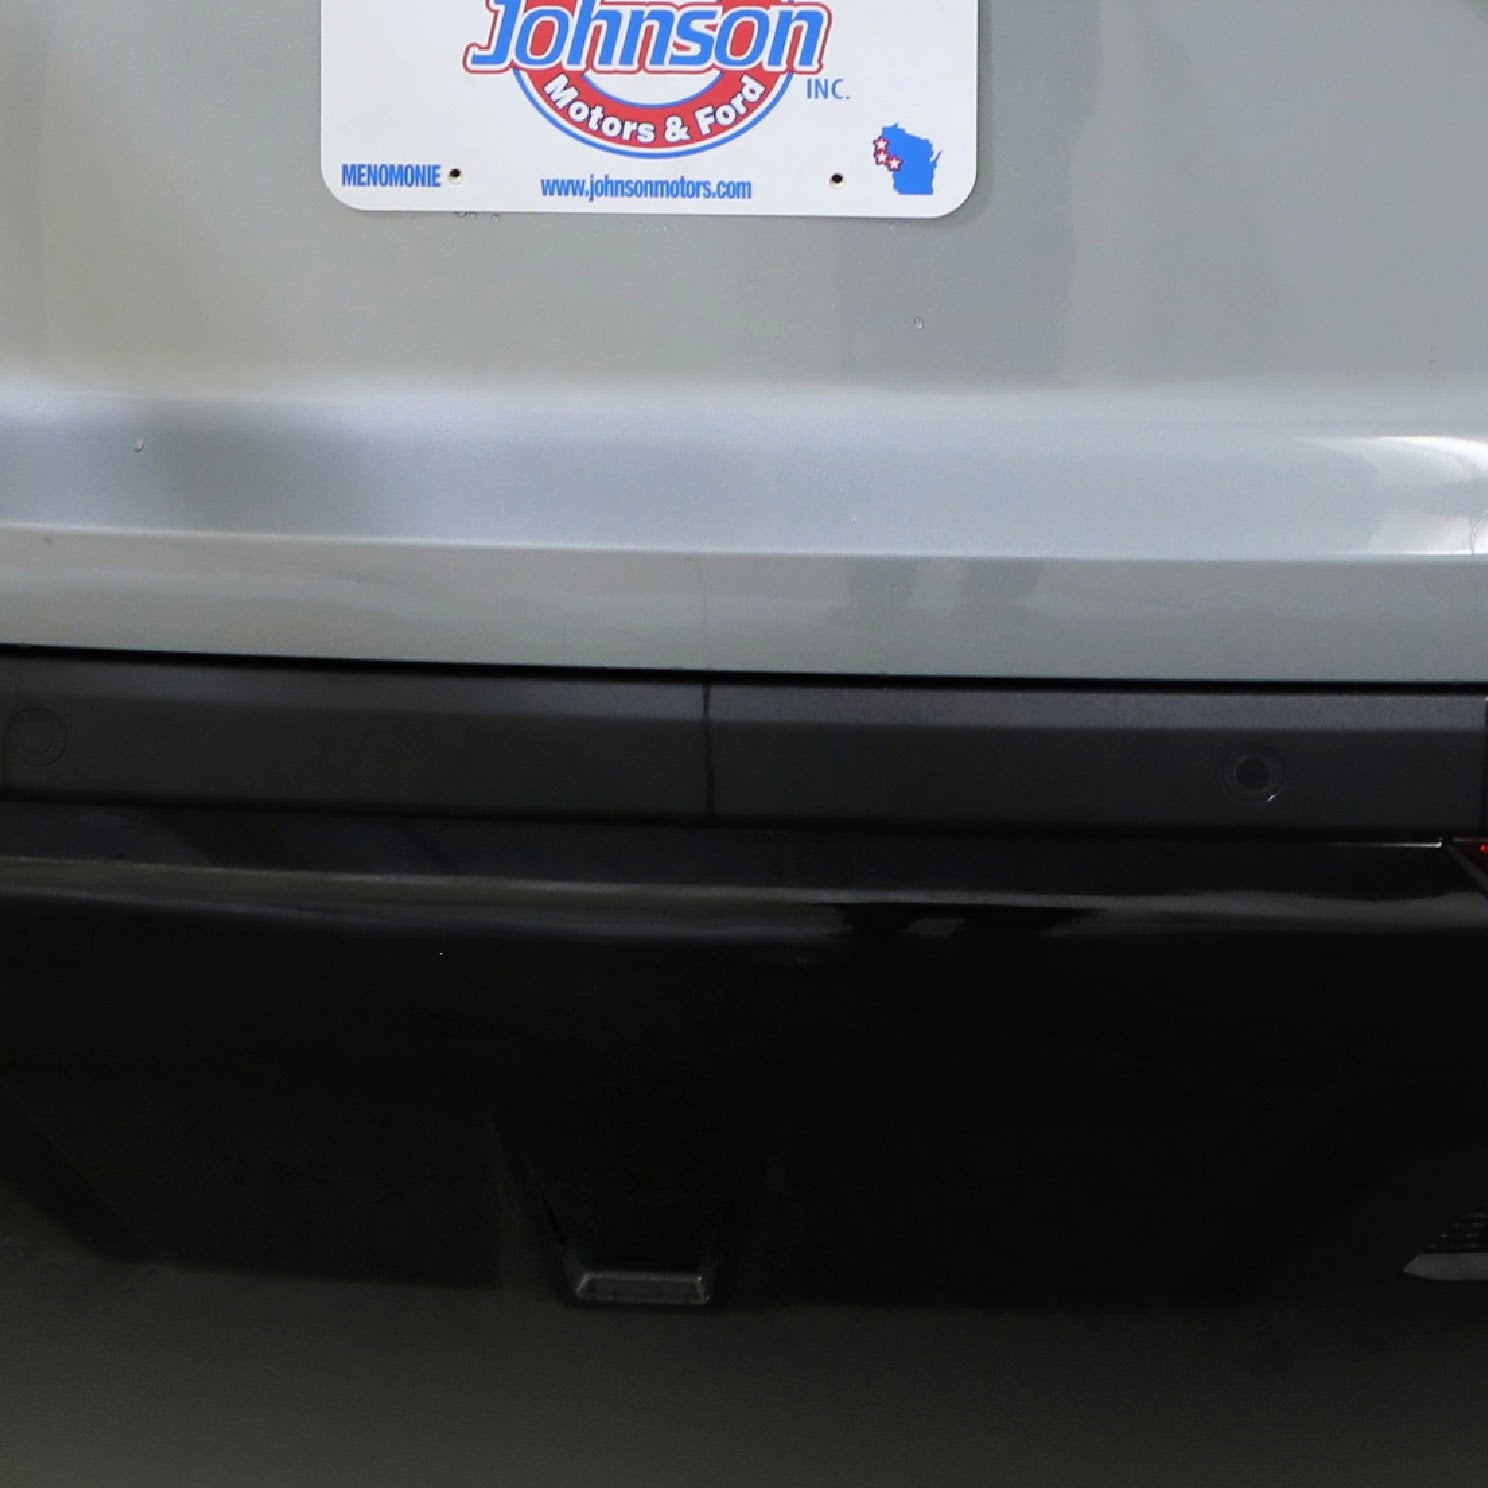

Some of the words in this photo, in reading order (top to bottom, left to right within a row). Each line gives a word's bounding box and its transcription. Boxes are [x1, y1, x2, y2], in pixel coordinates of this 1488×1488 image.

[806, 78, 850, 100] INC.
[542, 74, 656, 143] Motors
[664, 116, 691, 143] &
[695, 75, 766, 135] Ford
[341, 163, 442, 189] MENOMONIE
[540, 174, 752, 202] www.johnsonmotors.com
